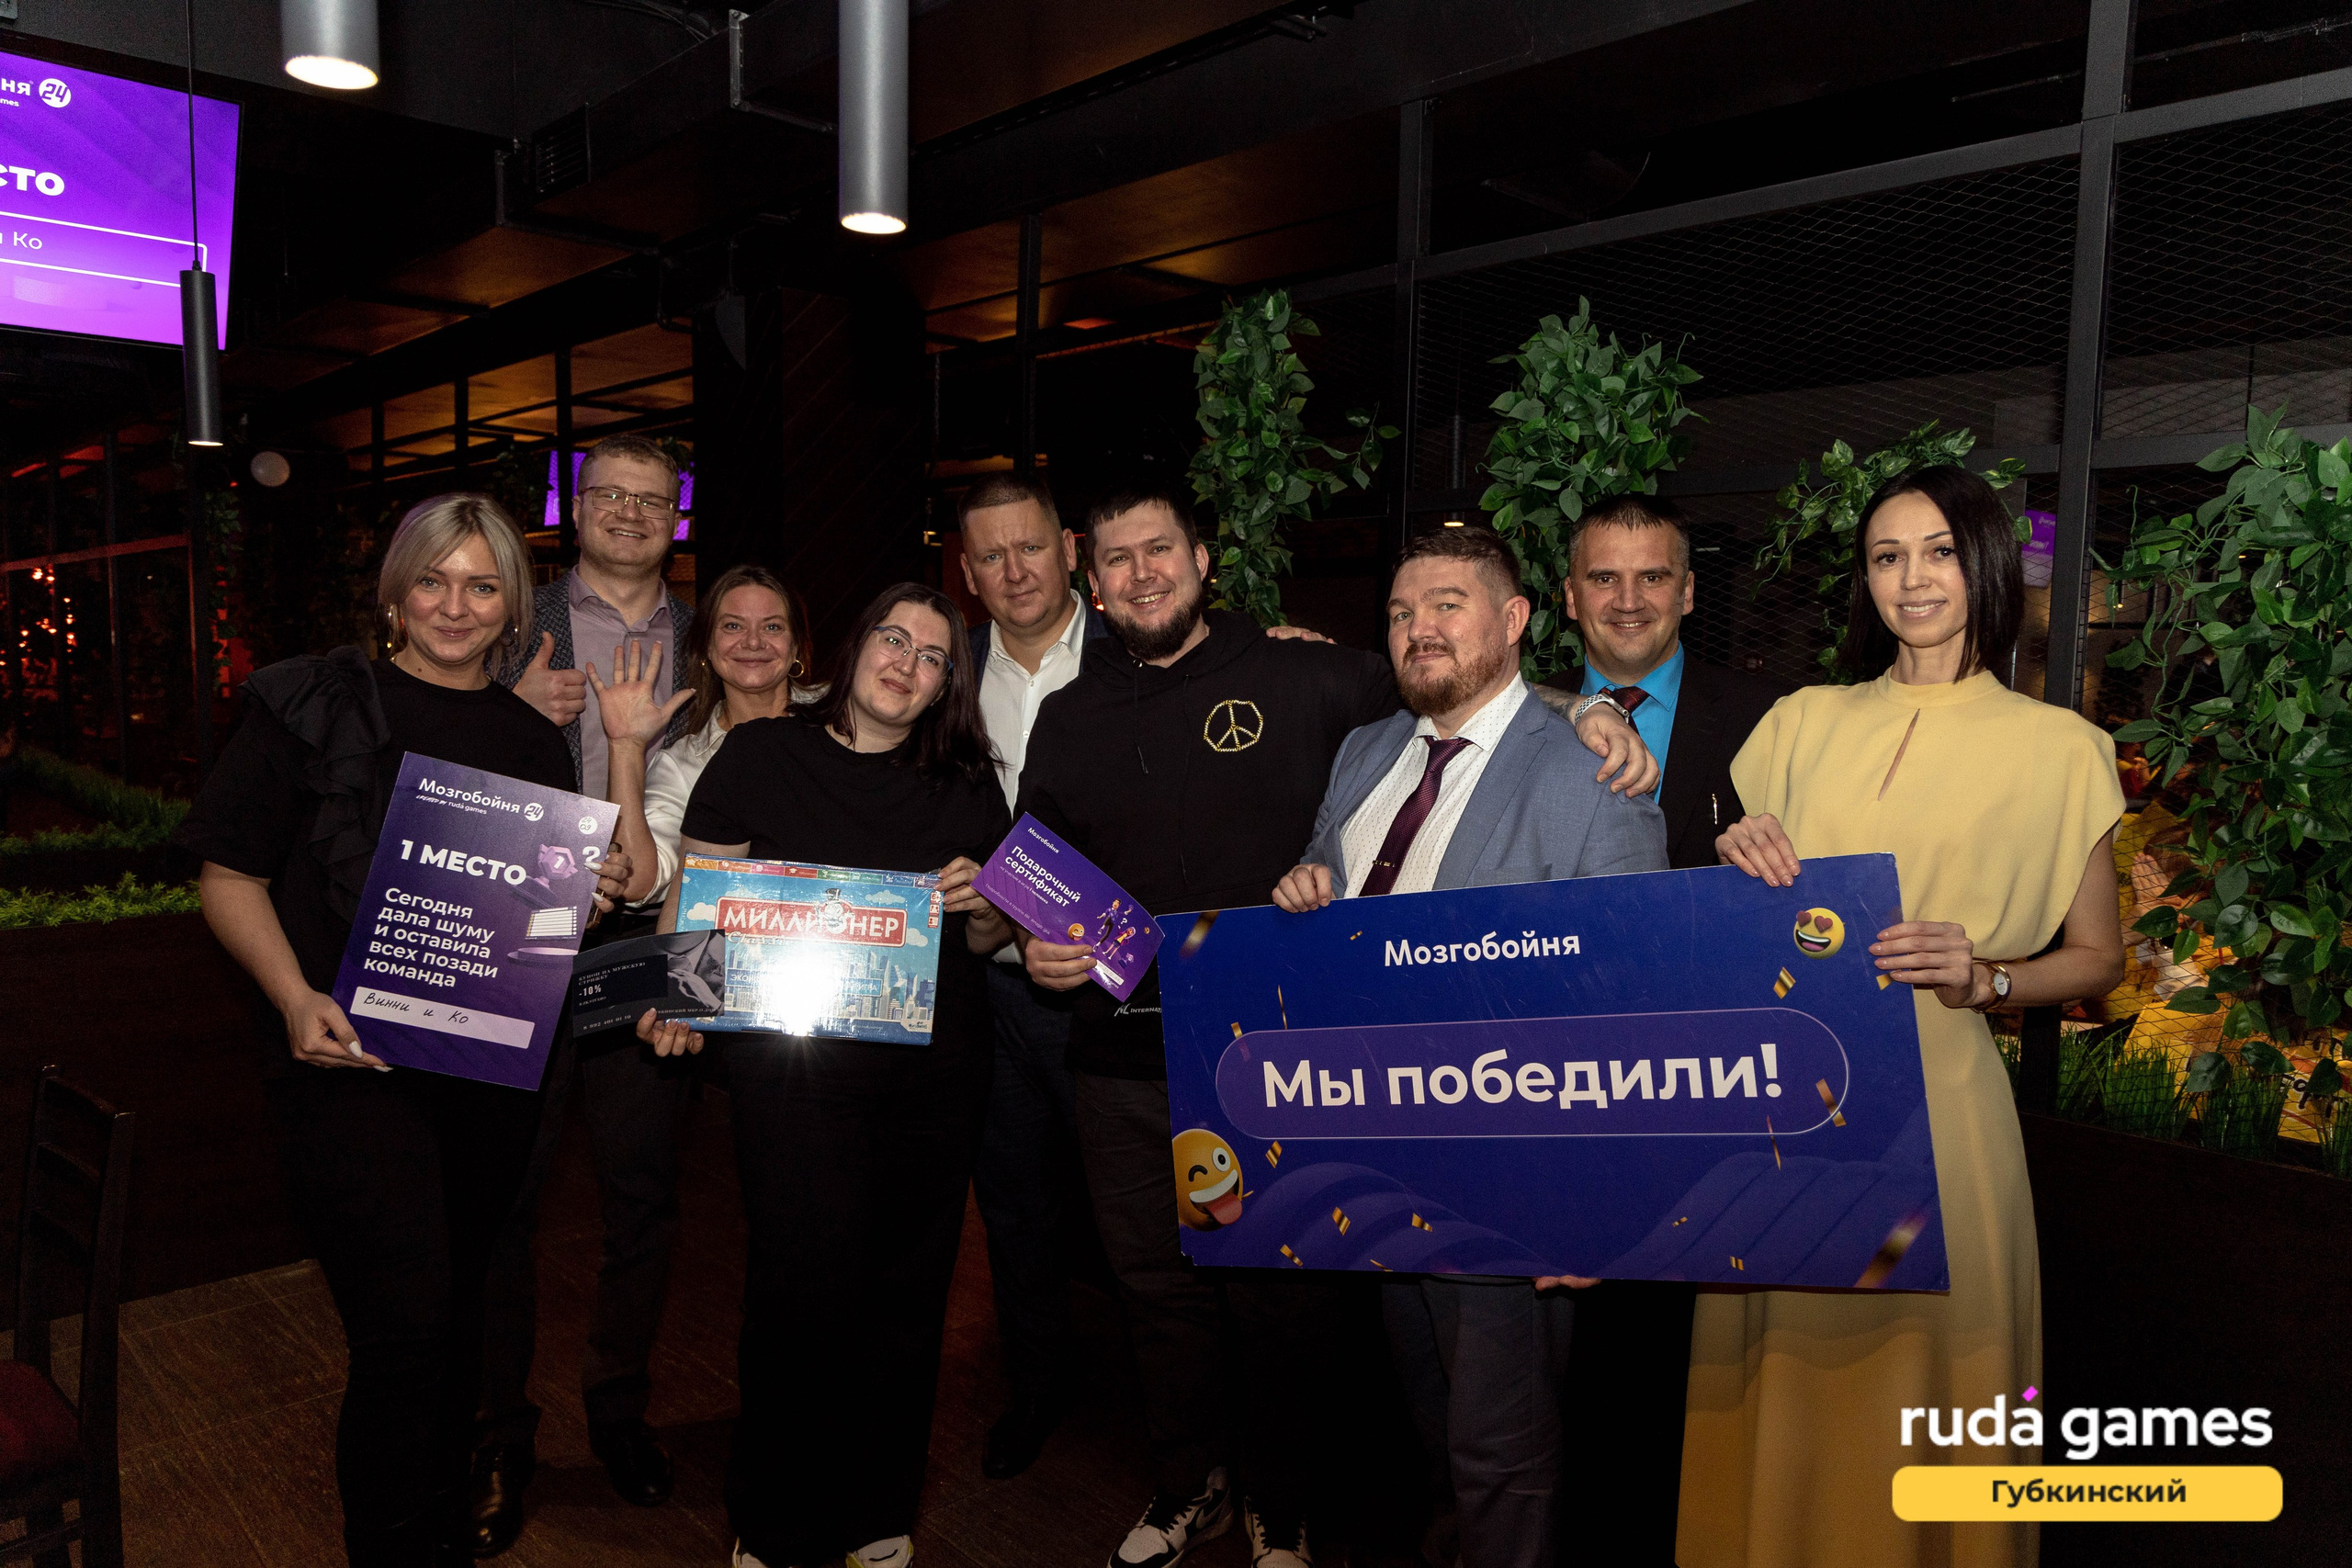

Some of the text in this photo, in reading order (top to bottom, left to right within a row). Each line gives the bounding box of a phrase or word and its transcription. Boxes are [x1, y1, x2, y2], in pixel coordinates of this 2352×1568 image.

[0, 164, 65, 197] ТО
[419, 778, 543, 820] Мозгобойня 24
[464, 805, 488, 815] games
[1027, 827, 1059, 854] Мозгобойня
[401, 840, 526, 886] 1 МЕСТО
[1012, 845, 1081, 903] Подарочный
[1005, 855, 1069, 908] сертификат
[385, 887, 473, 920] Сегодня
[374, 924, 492, 959] и оставила
[378, 907, 495, 944] дала шуму
[368, 942, 498, 979] всех позади
[1384, 931, 1581, 967] Мозгобойня
[363, 958, 457, 988] команда
[579, 984, 602, 997] -10%
[364, 992, 411, 1012] Винни
[1261, 1043, 1784, 1111] Мы победили!
